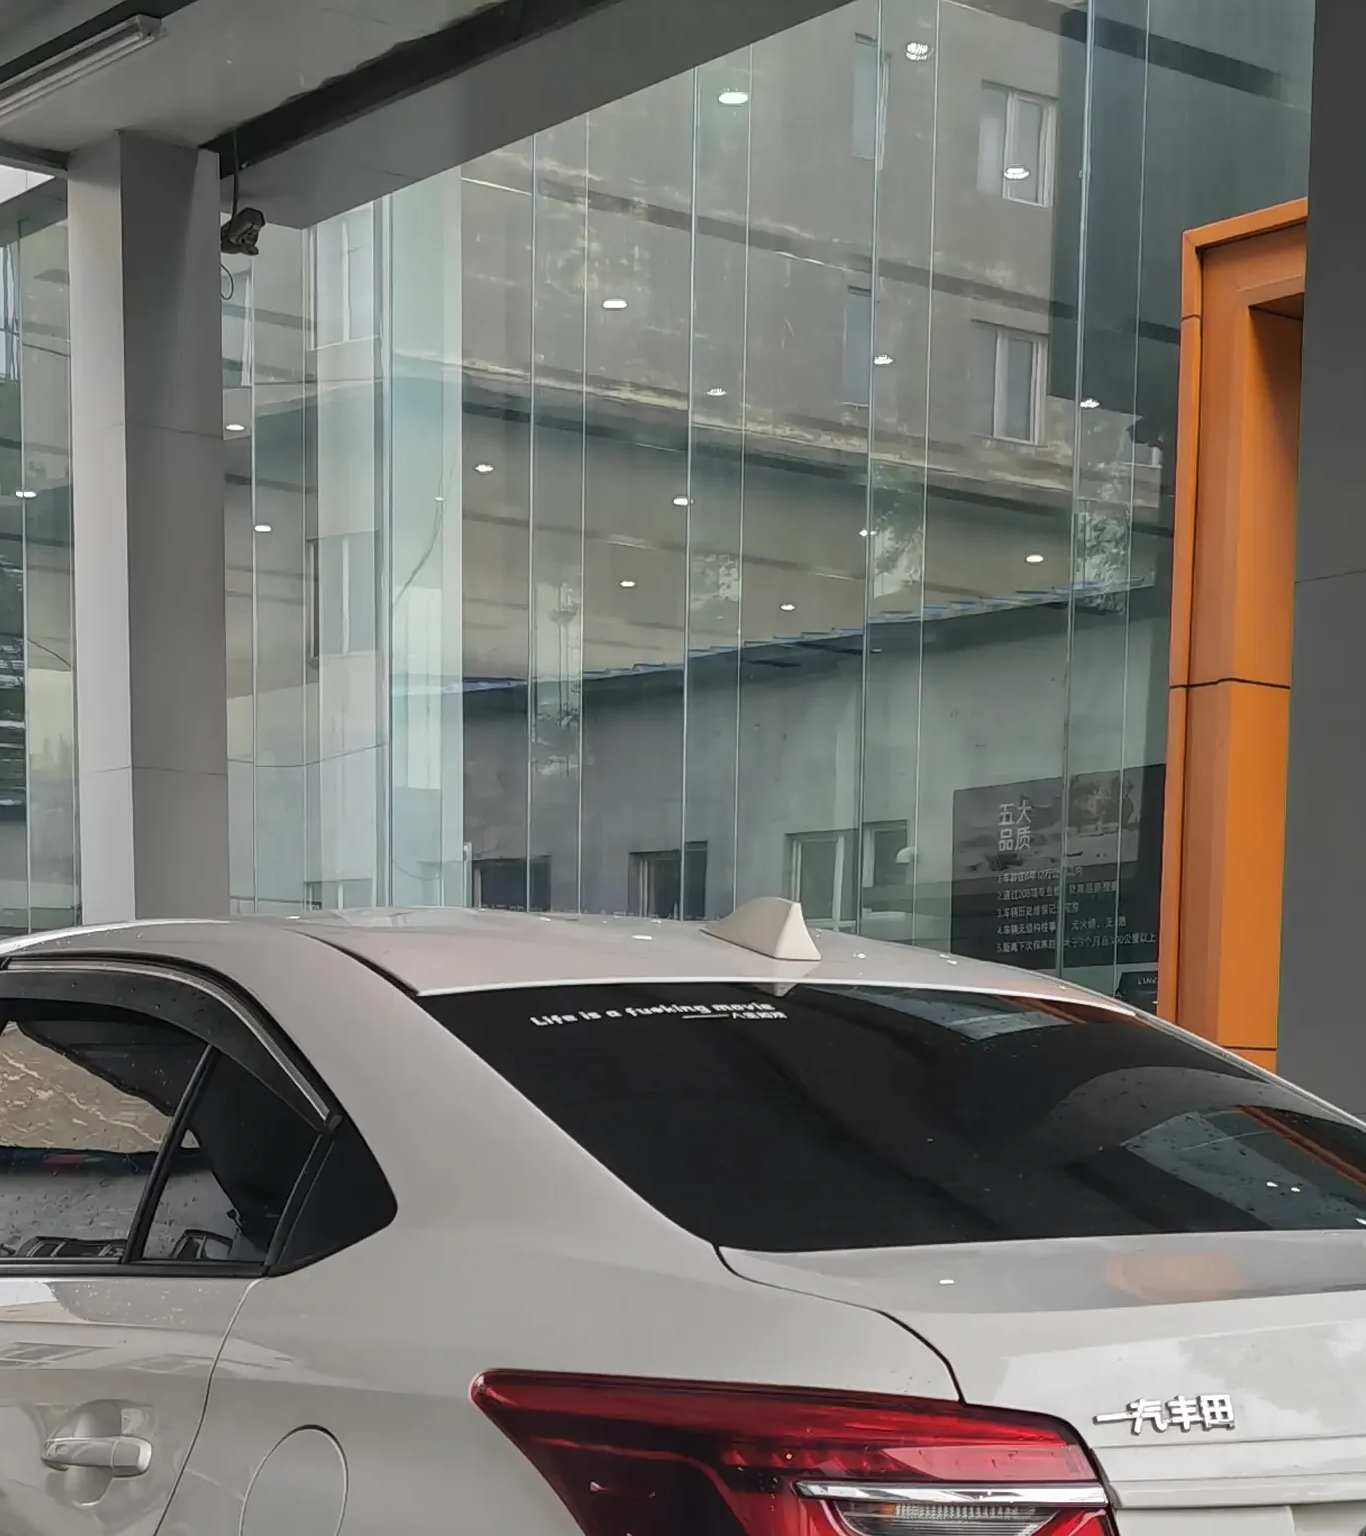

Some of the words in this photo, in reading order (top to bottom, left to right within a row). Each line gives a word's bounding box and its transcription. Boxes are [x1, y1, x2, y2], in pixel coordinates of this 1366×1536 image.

[998, 799, 1032, 826] 五大
[998, 826, 1032, 852] 品质
[530, 1014, 578, 1026] Life
[579, 1011, 602, 1020] is
[712, 1001, 776, 1011] movie
[1093, 1395, 1235, 1435] 一汽丰田
